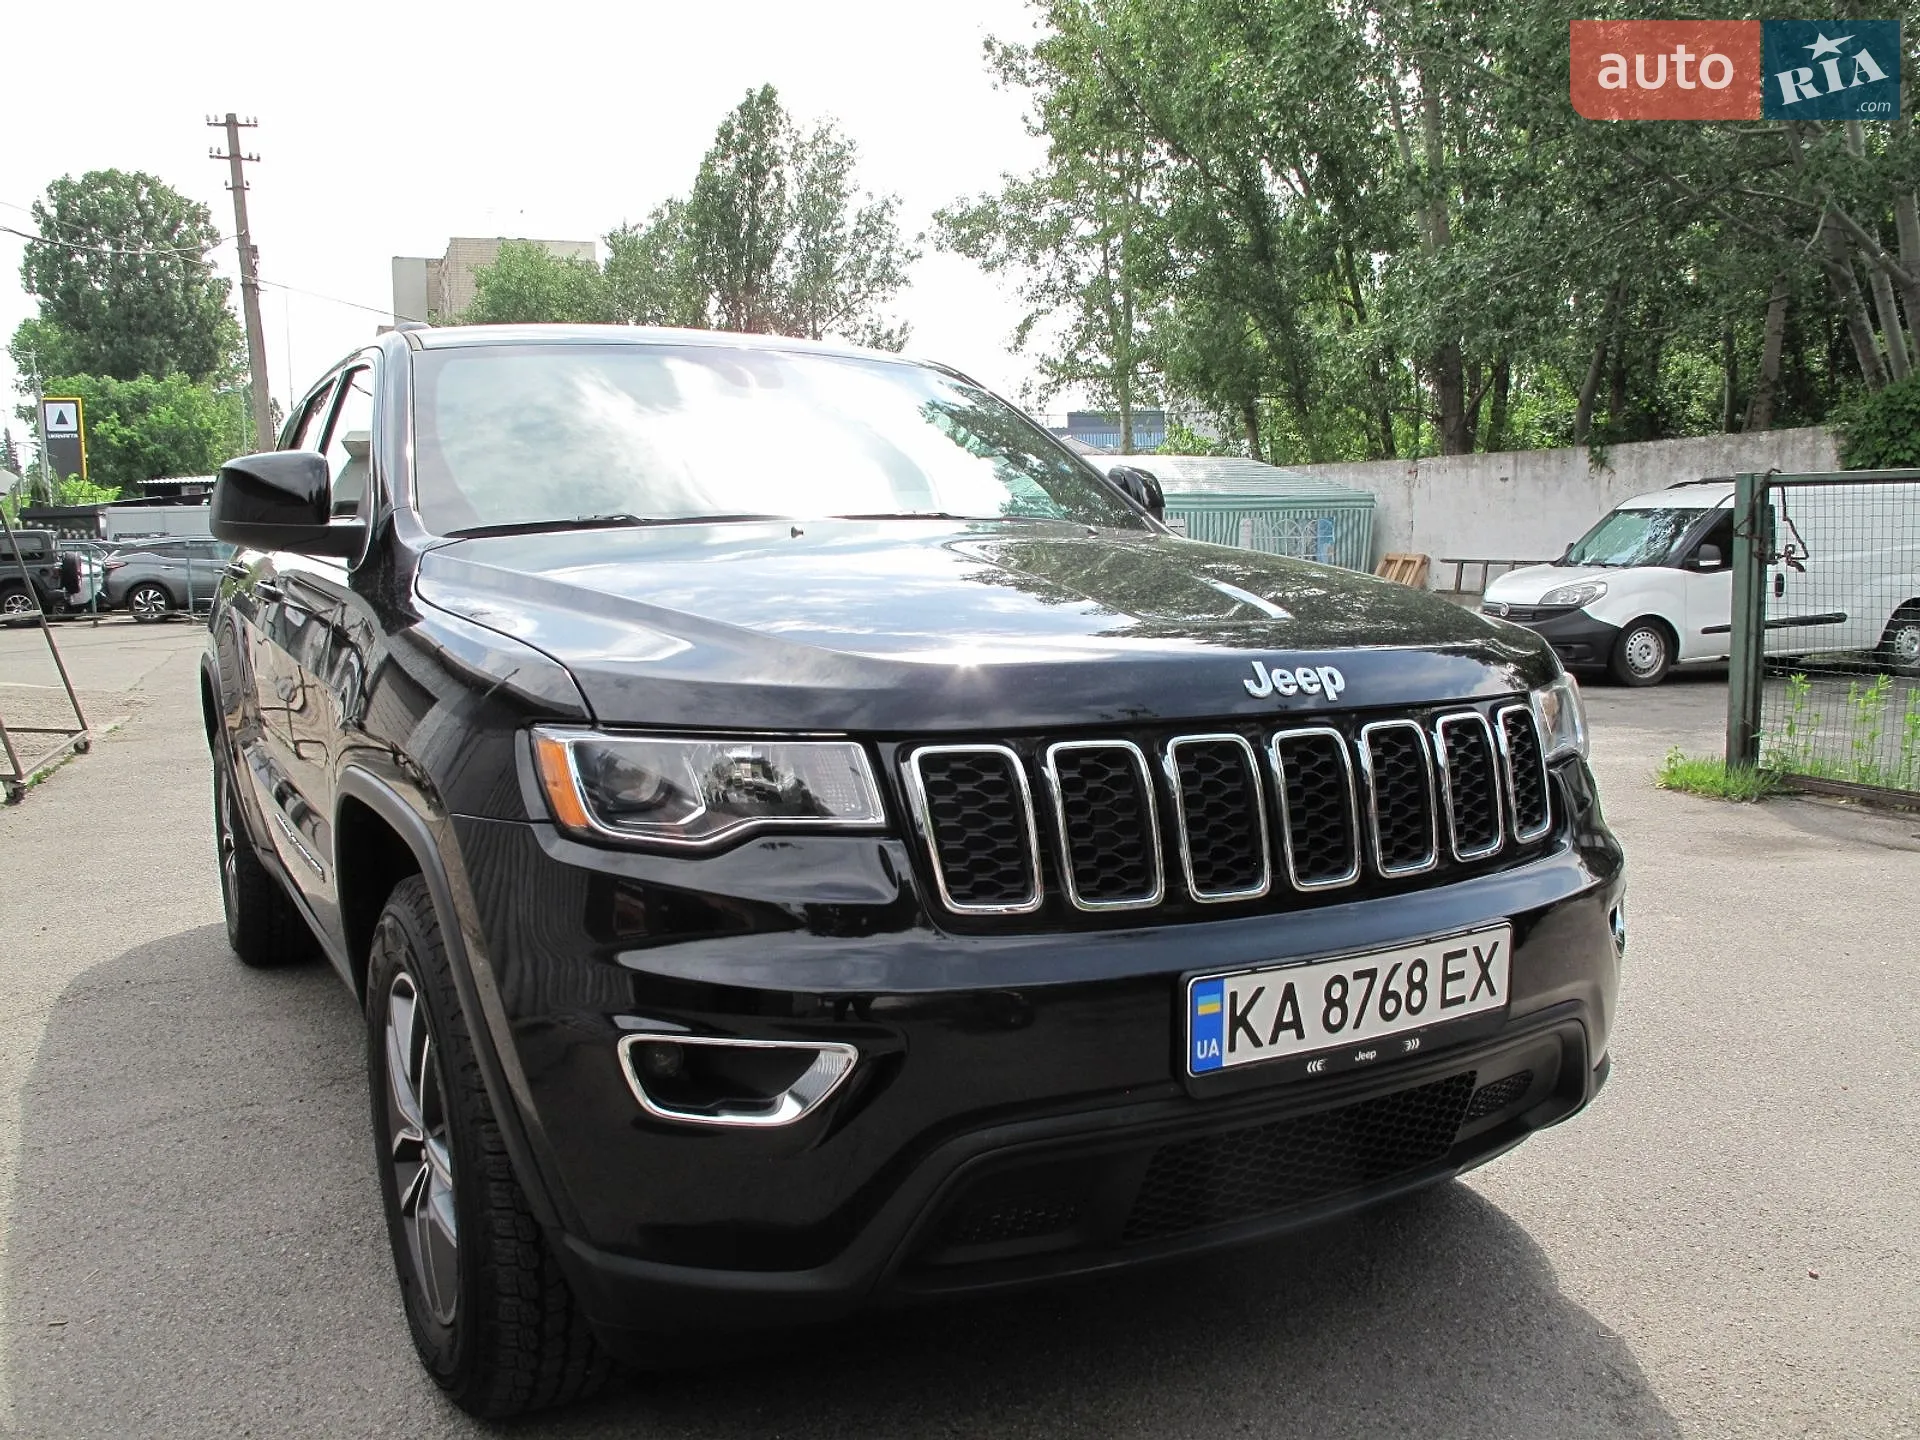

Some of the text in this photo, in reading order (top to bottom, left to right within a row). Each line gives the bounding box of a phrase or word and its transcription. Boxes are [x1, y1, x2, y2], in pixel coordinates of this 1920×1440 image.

[1243, 661, 1346, 701] Jeep
[1228, 941, 1499, 1053] KA 8768 EX
[1196, 1040, 1220, 1060] UA
[1354, 1050, 1377, 1062] Jeep
